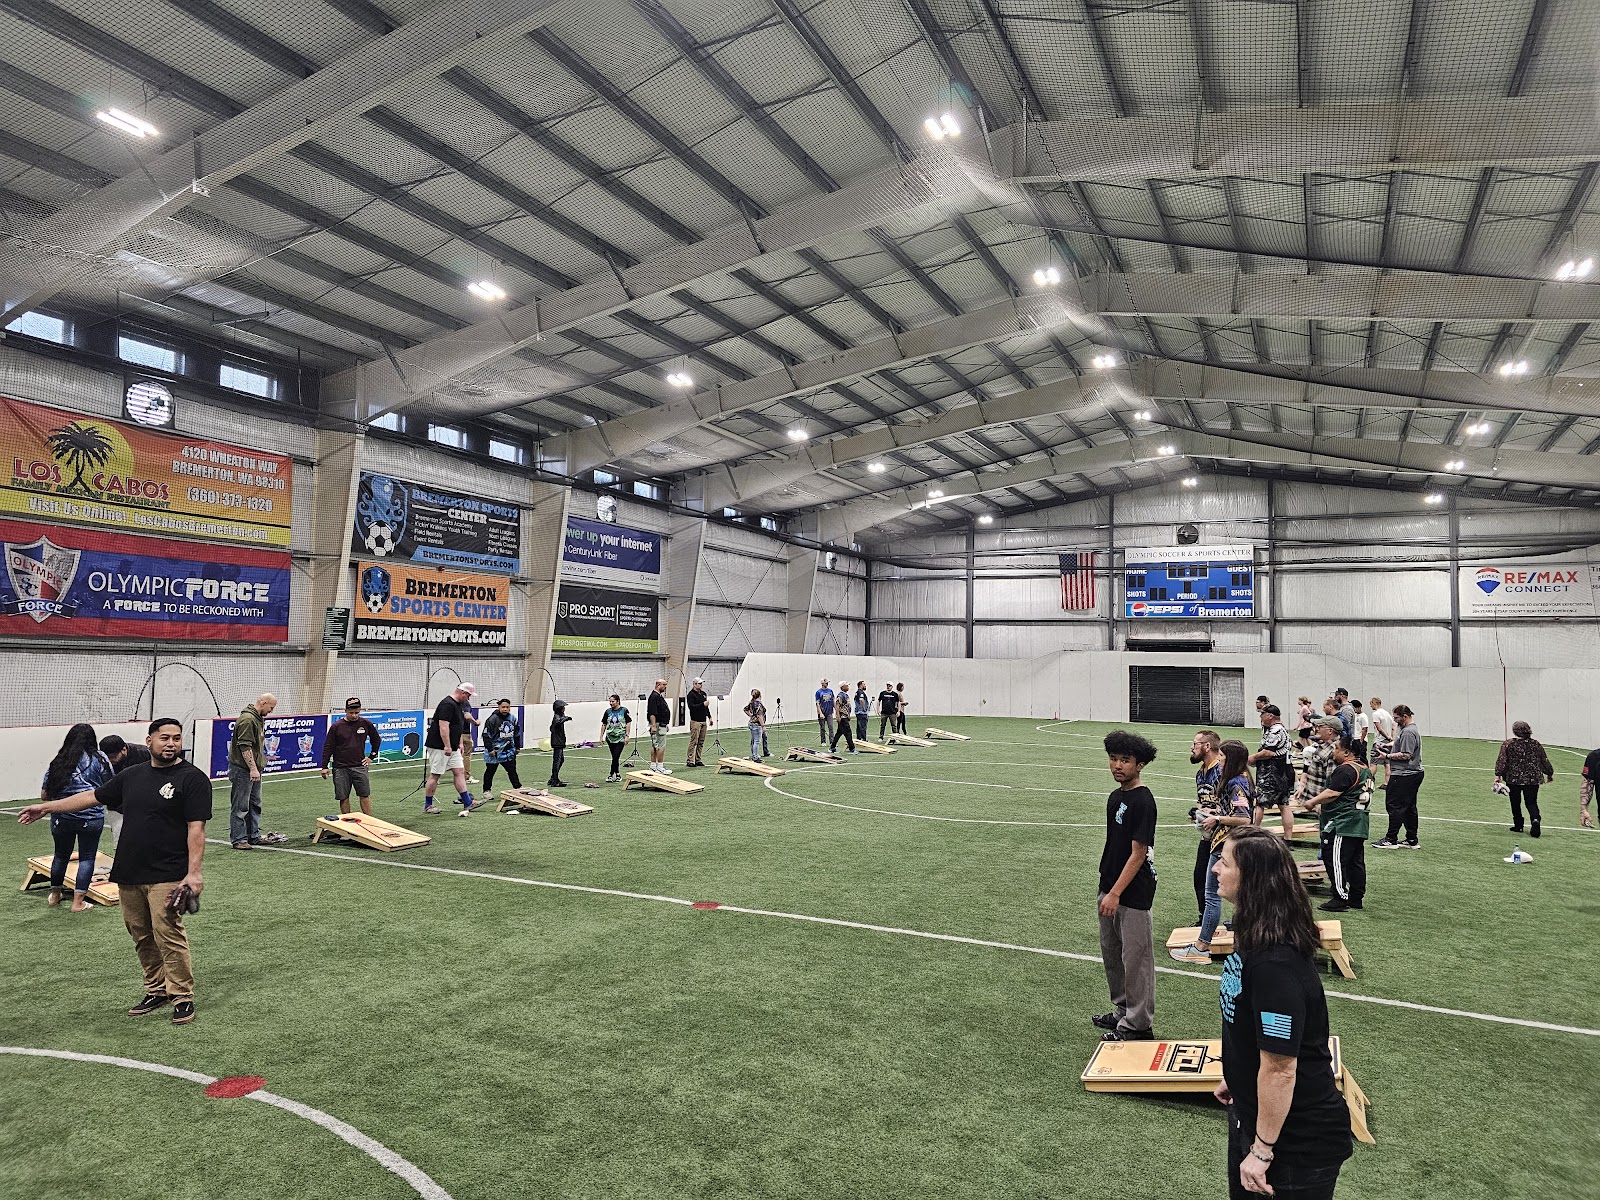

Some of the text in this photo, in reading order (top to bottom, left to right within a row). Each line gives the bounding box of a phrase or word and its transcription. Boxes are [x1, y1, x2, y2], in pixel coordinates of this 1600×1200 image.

[257, 459, 278, 474] WAY
[11, 477, 52, 492] FAMILY
[14, 457, 169, 500] LOS CABOS
[237, 471, 254, 486] WA
[186, 486, 220, 505] (360)
[411, 488, 518, 518] BREMERTON SPORTS
[28, 496, 60, 514] Visit
[63, 502, 79, 516] Us
[82, 505, 127, 523] Online!
[447, 508, 487, 524] CENTER
[587, 531, 598, 545] up
[600, 533, 620, 547] your
[621, 535, 653, 552] internet
[568, 544, 602, 559] CenturyLink
[1195, 549, 1220, 557] SPORTS
[422, 550, 514, 570] BREMERTONSPORTS.COM
[1227, 565, 1252, 573] GUEST
[1504, 571, 1578, 584] RE/MAX
[88, 571, 270, 604] OLYMPICFORCE
[405, 578, 497, 602] BREMERTON
[1505, 585, 1570, 593] CONNECT
[17, 600, 64, 614] FORCE
[102, 600, 264, 618] A FORCE TO BE RECKONED WITH
[390, 596, 507, 620] SPORTS CENTER
[570, 603, 588, 615] PRO
[589, 605, 616, 618] SPORT
[1146, 604, 1252, 617] PEPSI of Bremerton
[356, 625, 506, 645] BREMERTONSPORTS.COM
